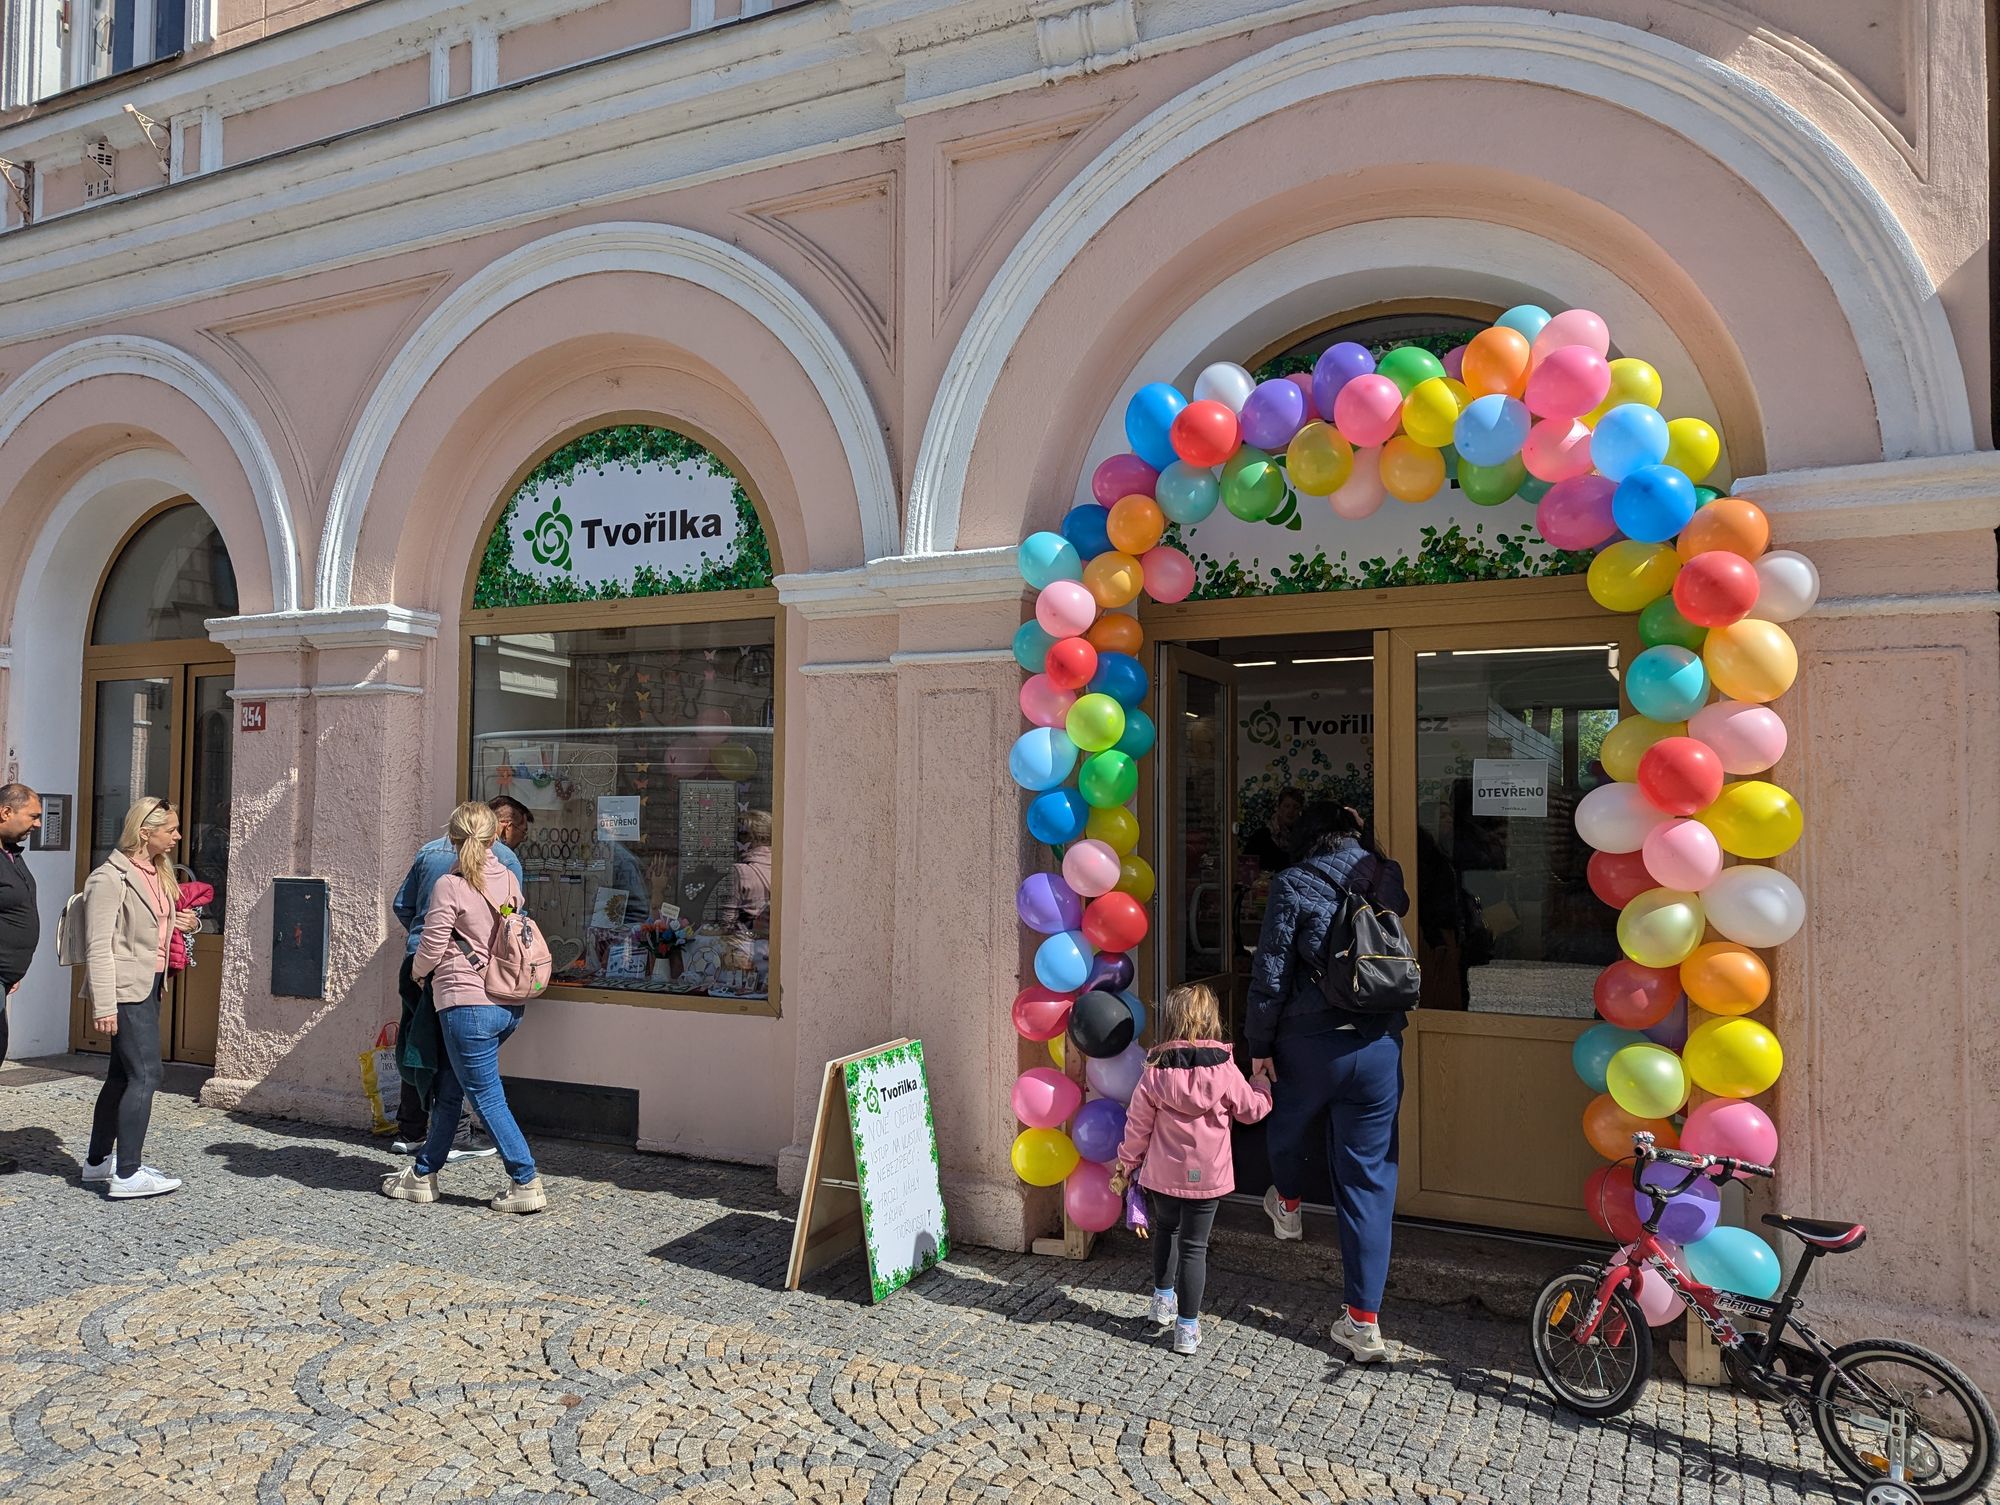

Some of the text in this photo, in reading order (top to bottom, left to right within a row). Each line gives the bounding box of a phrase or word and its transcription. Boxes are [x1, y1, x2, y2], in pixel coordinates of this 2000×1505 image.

[581, 509, 722, 549] Tvořilka
[242, 706, 262, 727] 354
[1478, 785, 1544, 798] OTEVŘENO
[600, 816, 638, 828] OTEVŘENO
[880, 1078, 917, 1102] Tvořilka
[1654, 1263, 1726, 1336] FLASH
[1716, 1297, 1775, 1318] PRIDE
